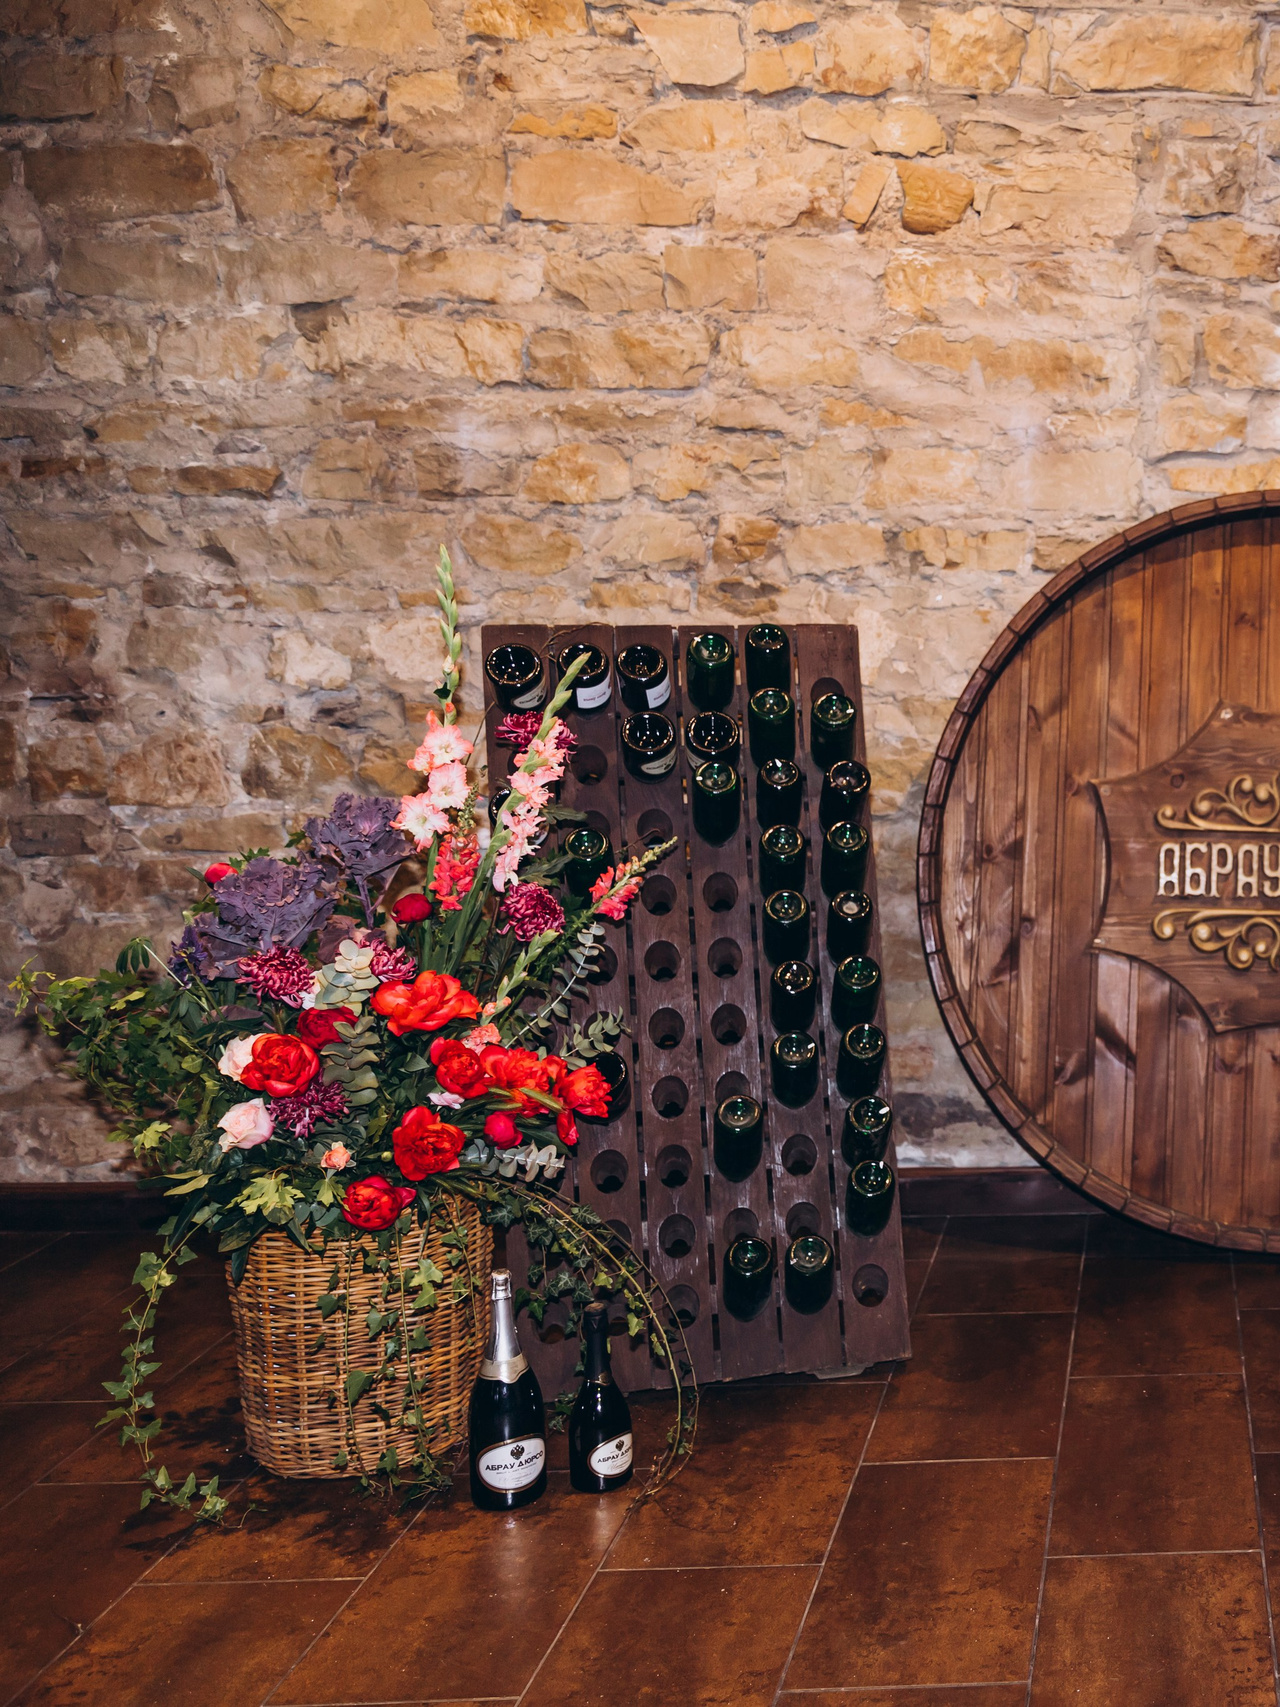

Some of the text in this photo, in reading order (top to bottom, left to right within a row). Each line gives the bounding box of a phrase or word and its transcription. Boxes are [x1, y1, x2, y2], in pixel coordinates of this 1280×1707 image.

[485, 1462, 515, 1471] АБРАУ
[517, 1450, 544, 1468] ДЮРСО
[597, 1453, 620, 1464] АБРАУ
